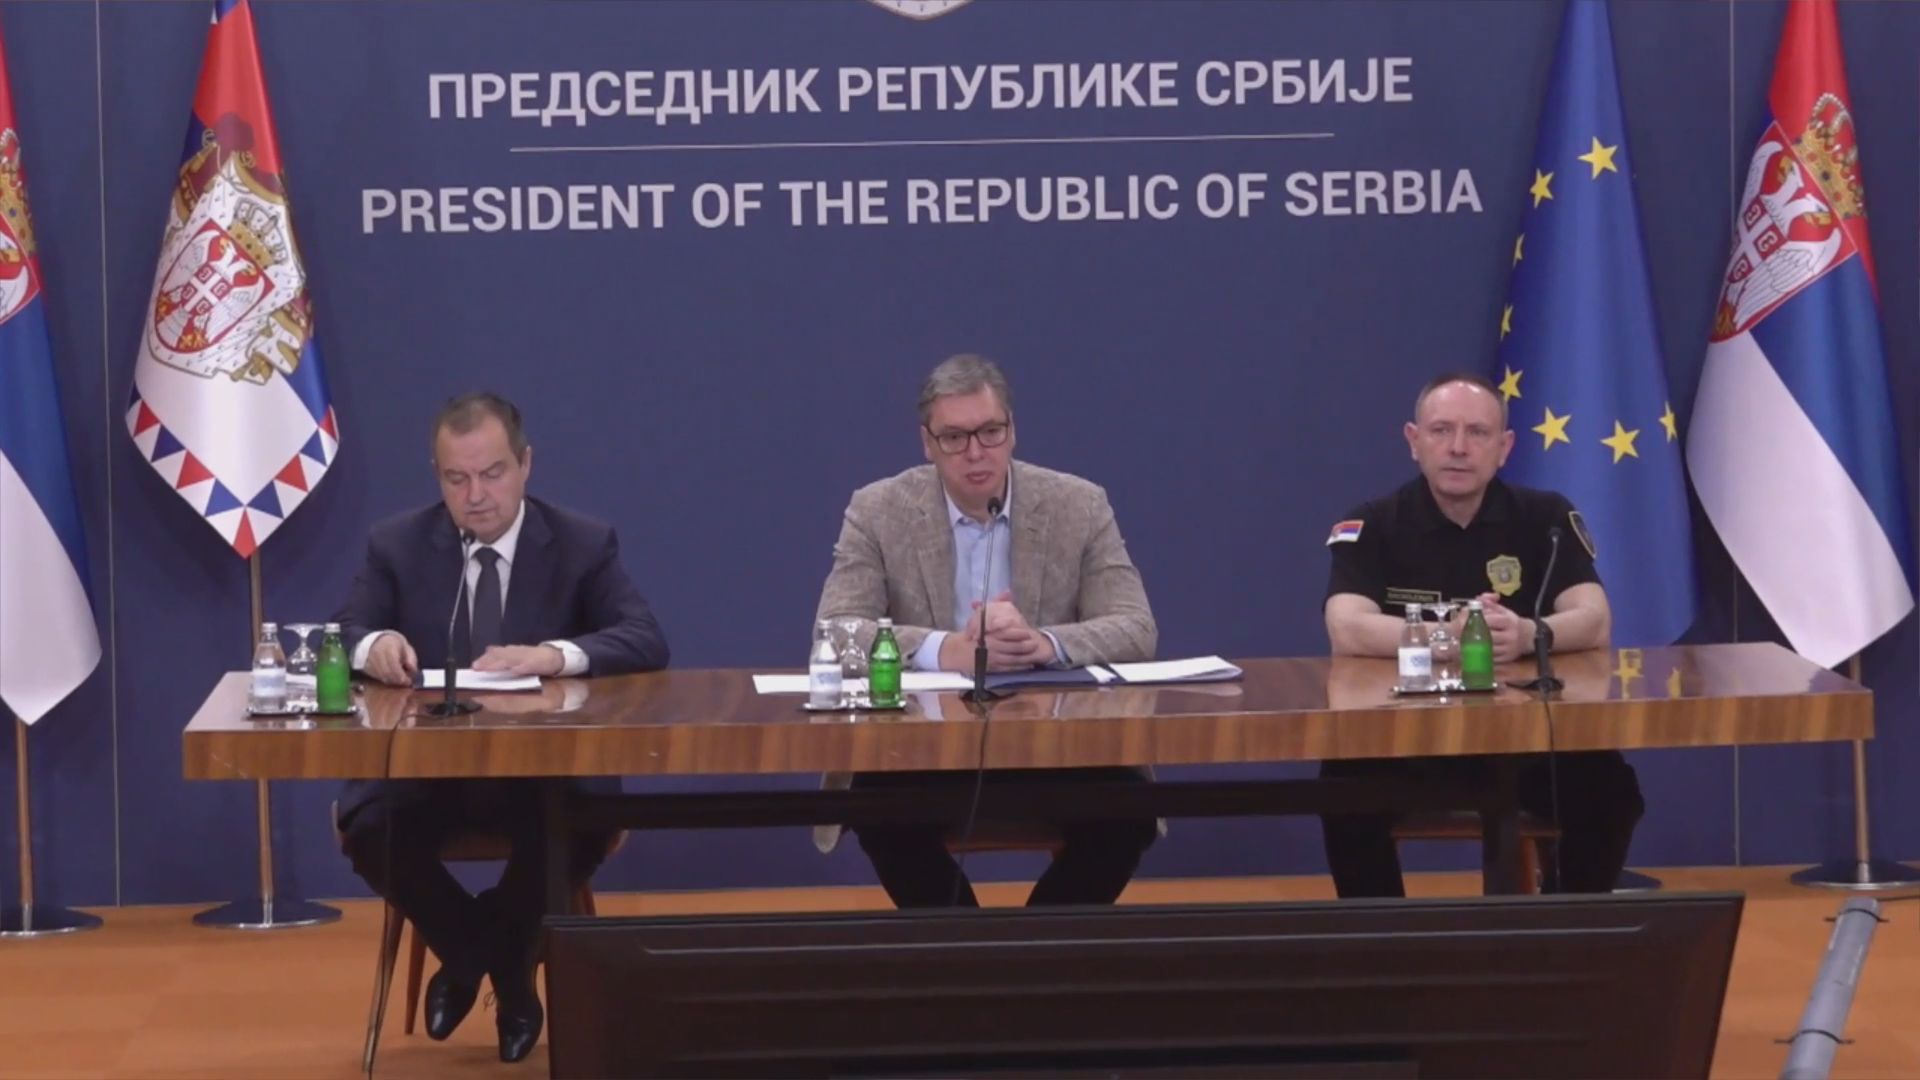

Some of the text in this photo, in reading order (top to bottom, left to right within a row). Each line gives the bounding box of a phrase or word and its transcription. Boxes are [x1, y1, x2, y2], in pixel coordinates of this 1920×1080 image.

[429, 57, 1413, 127] ПРЕДСЕДНИК РЕПУБЛИКЕ СРБИЈЕ
[362, 169, 1483, 234] PRESIDENT OF THE REPUBLIC OF SERBIA
